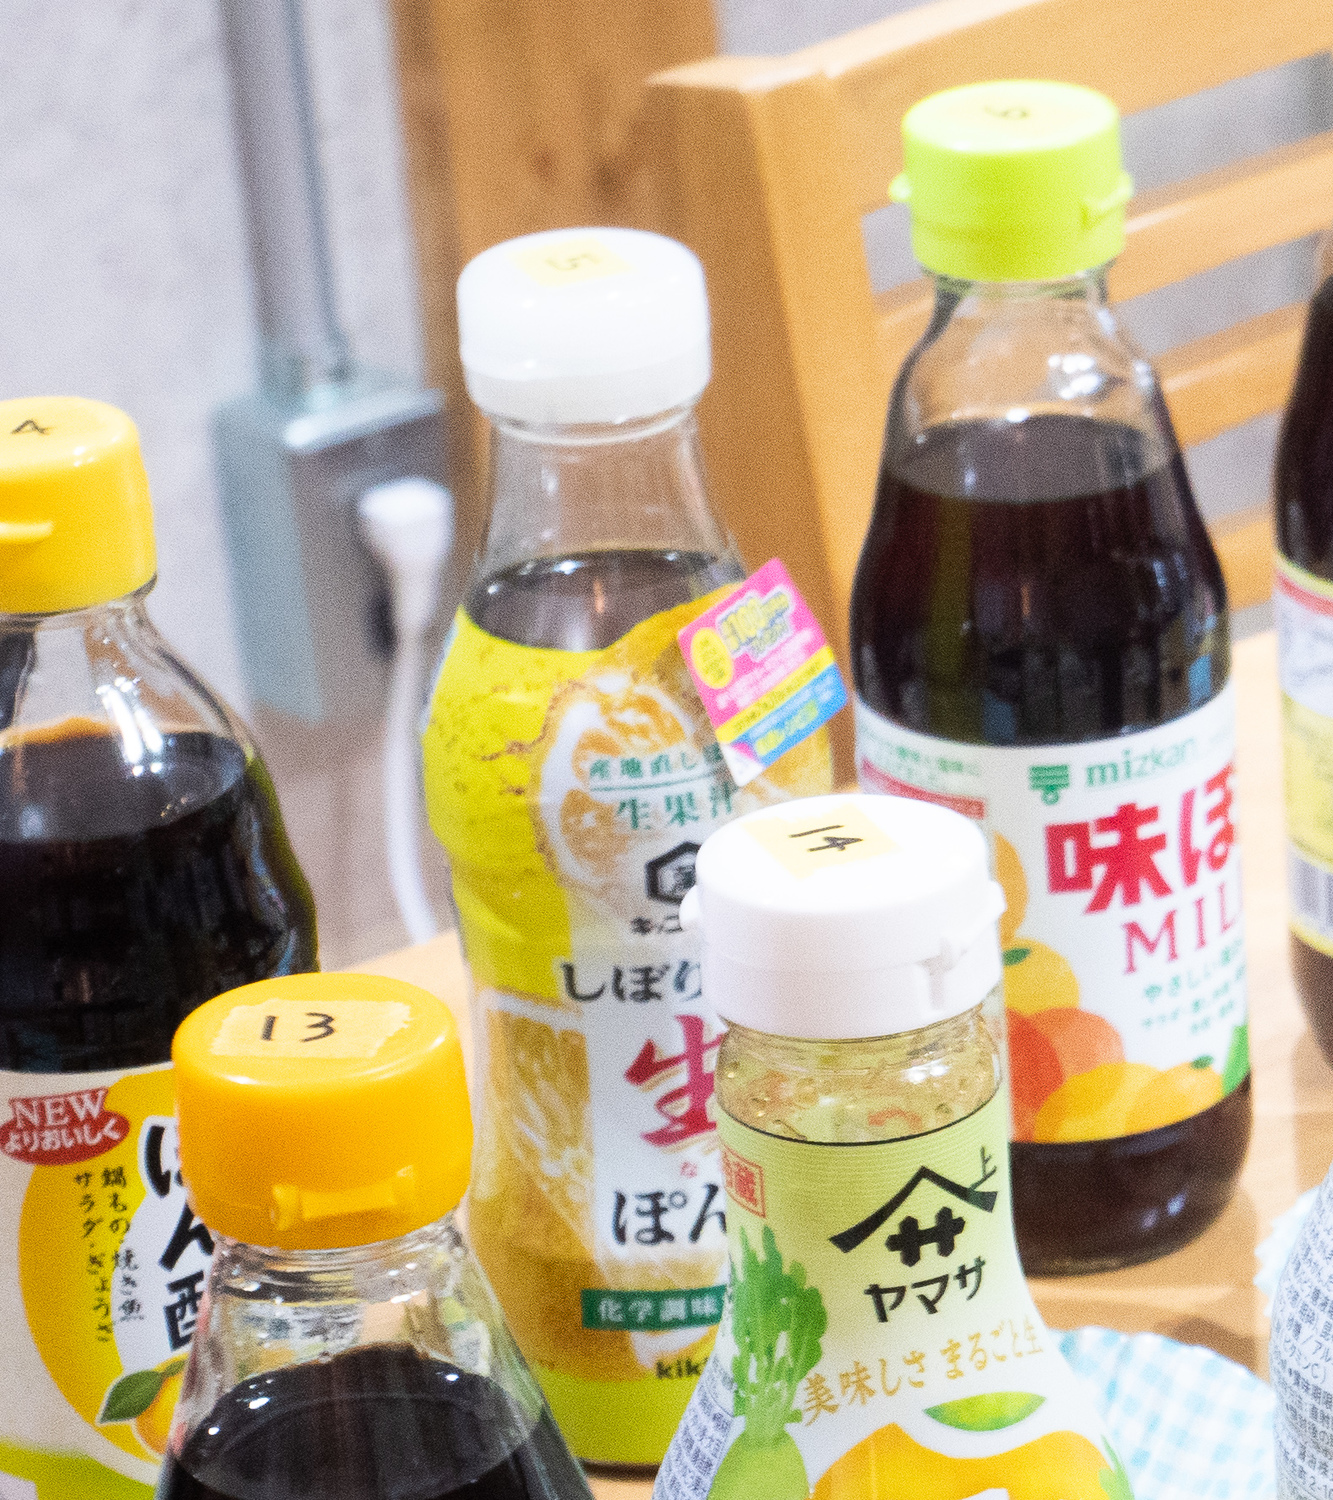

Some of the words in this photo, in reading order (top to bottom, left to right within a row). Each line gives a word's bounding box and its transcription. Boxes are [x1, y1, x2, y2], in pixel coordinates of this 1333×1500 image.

[261, 1012, 336, 1043] 13
[11, 1089, 109, 1132] NEW
[864, 1257, 986, 1324] ヤマサ
[803, 1350, 927, 1427] 美味しさ
